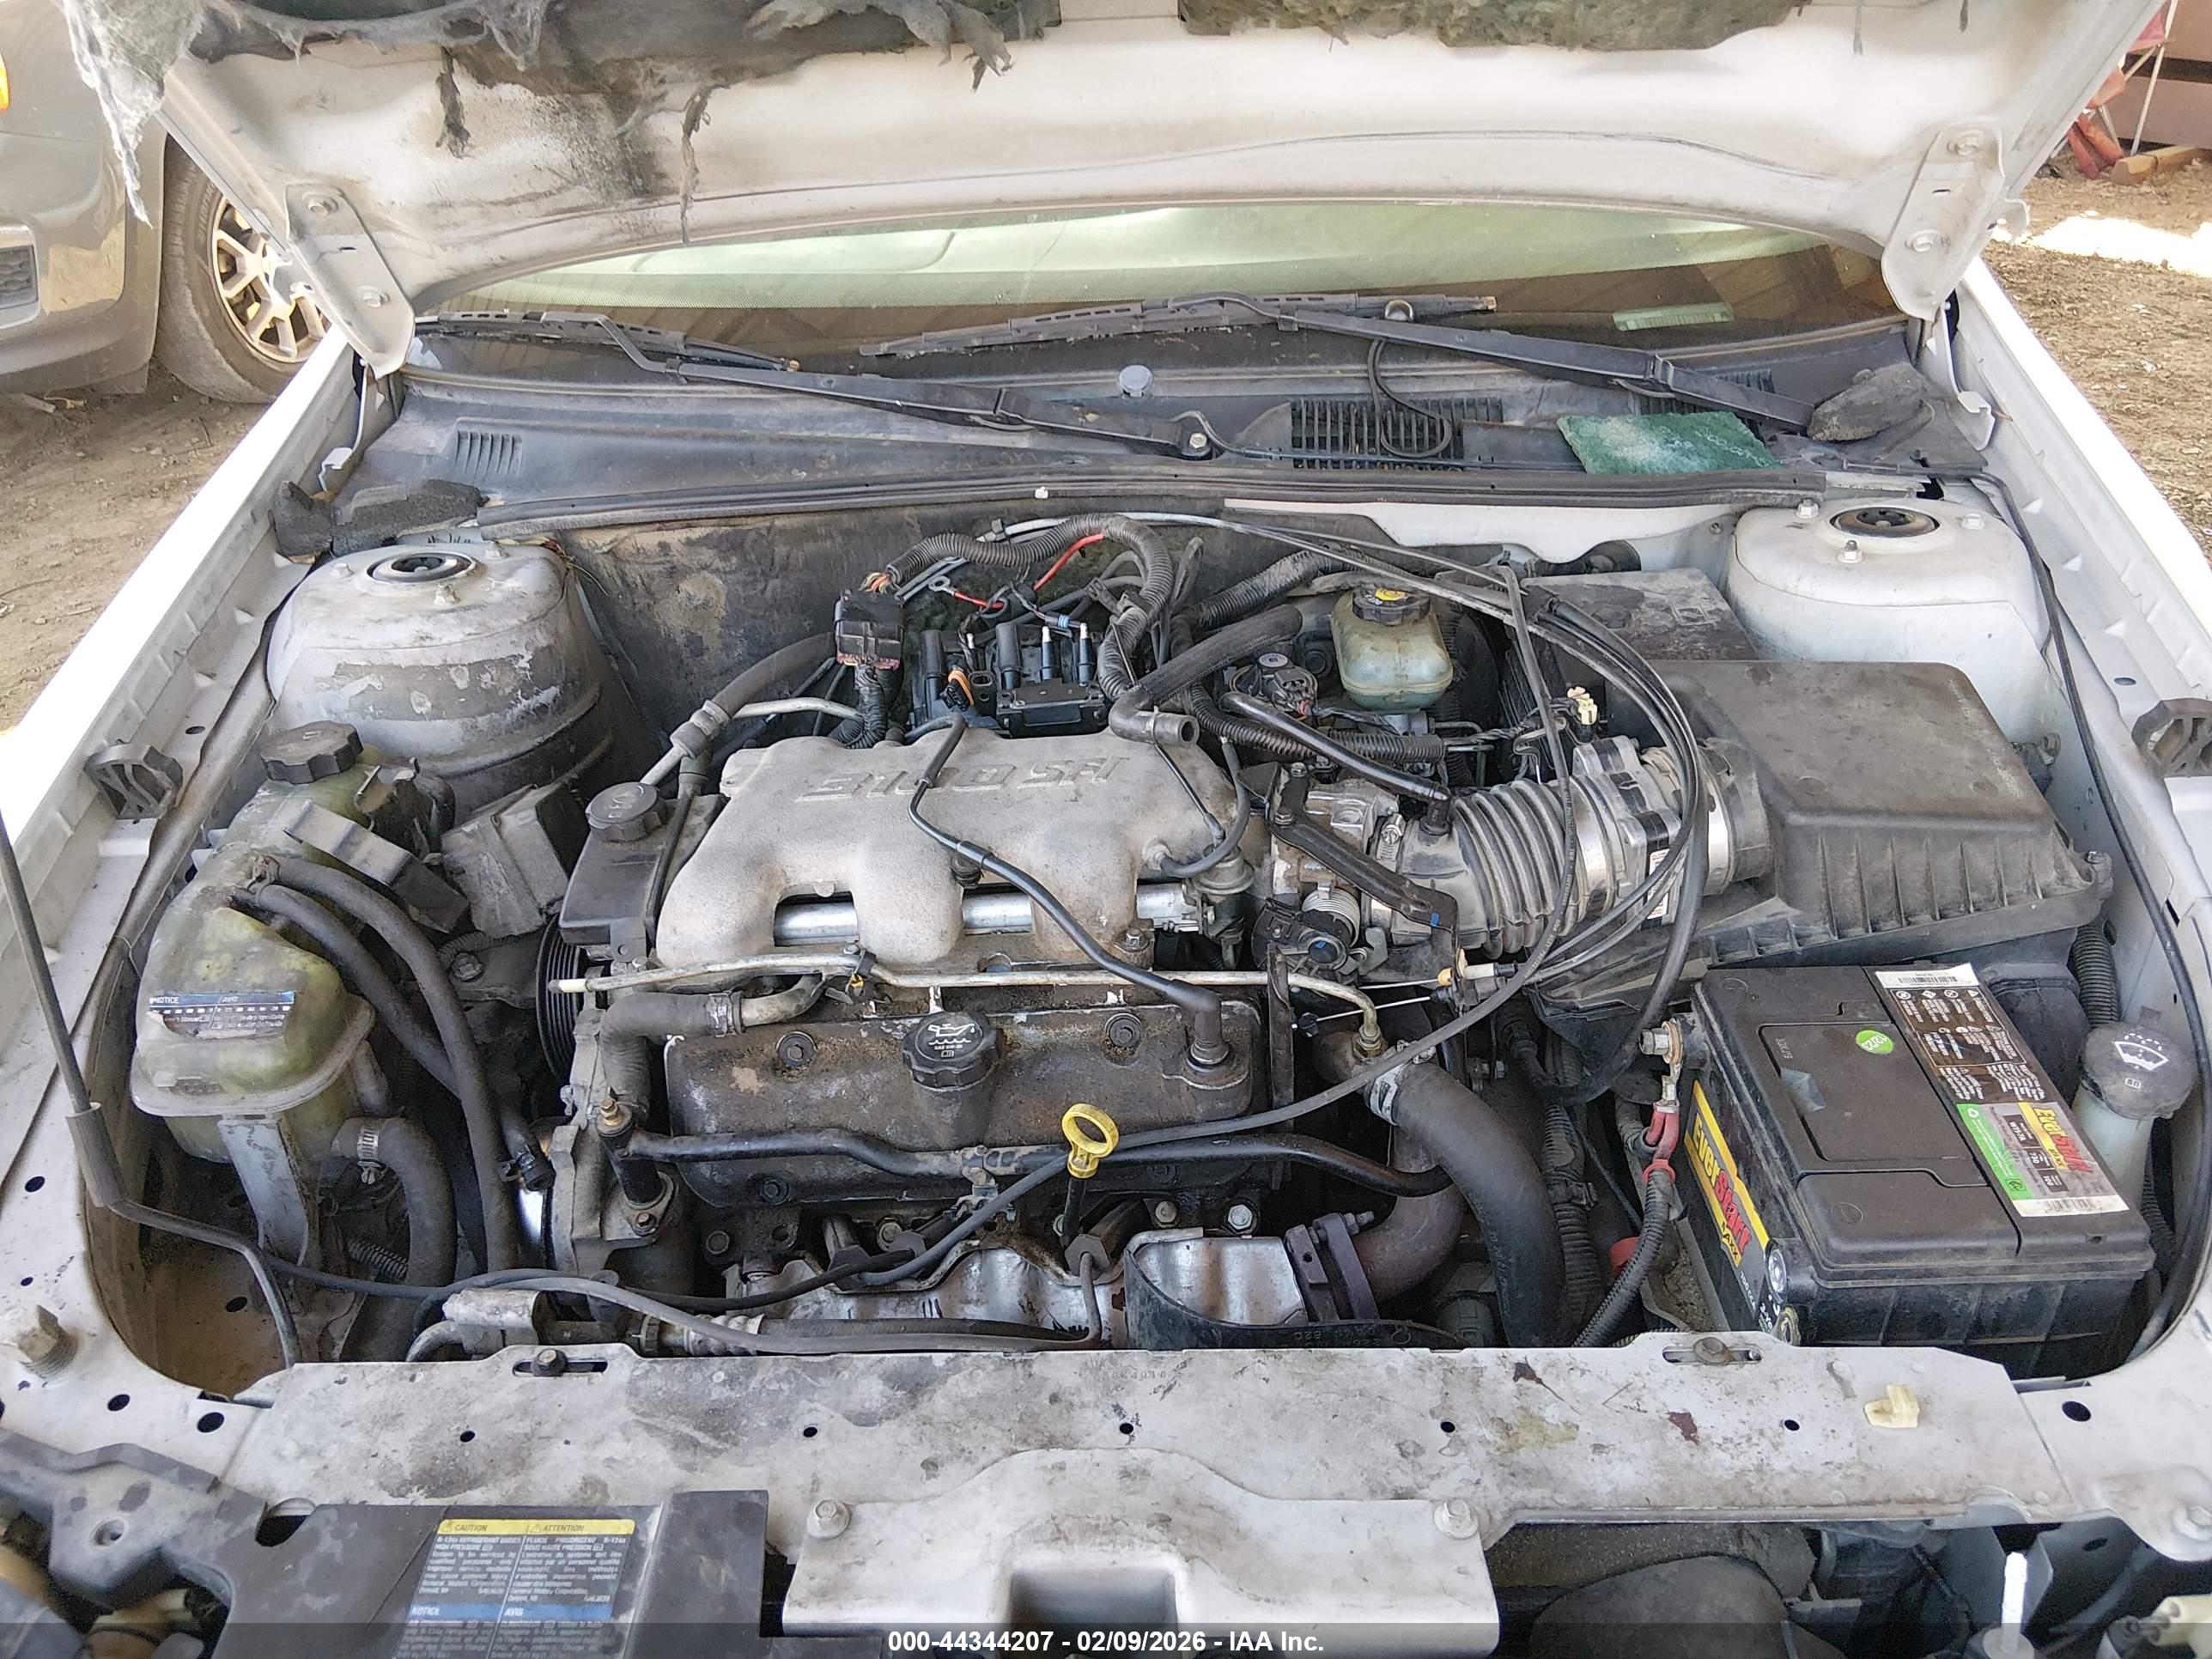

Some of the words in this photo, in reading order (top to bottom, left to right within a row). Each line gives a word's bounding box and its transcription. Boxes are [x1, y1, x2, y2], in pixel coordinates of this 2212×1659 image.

[1018, 757, 1130, 789] SFI
[2033, 1108, 2089, 1172] EverStart
[1692, 1111, 1751, 1256] EverStart
[543, 1524, 585, 1533] ATTENTION
[504, 1607, 524, 1617] AVIS
